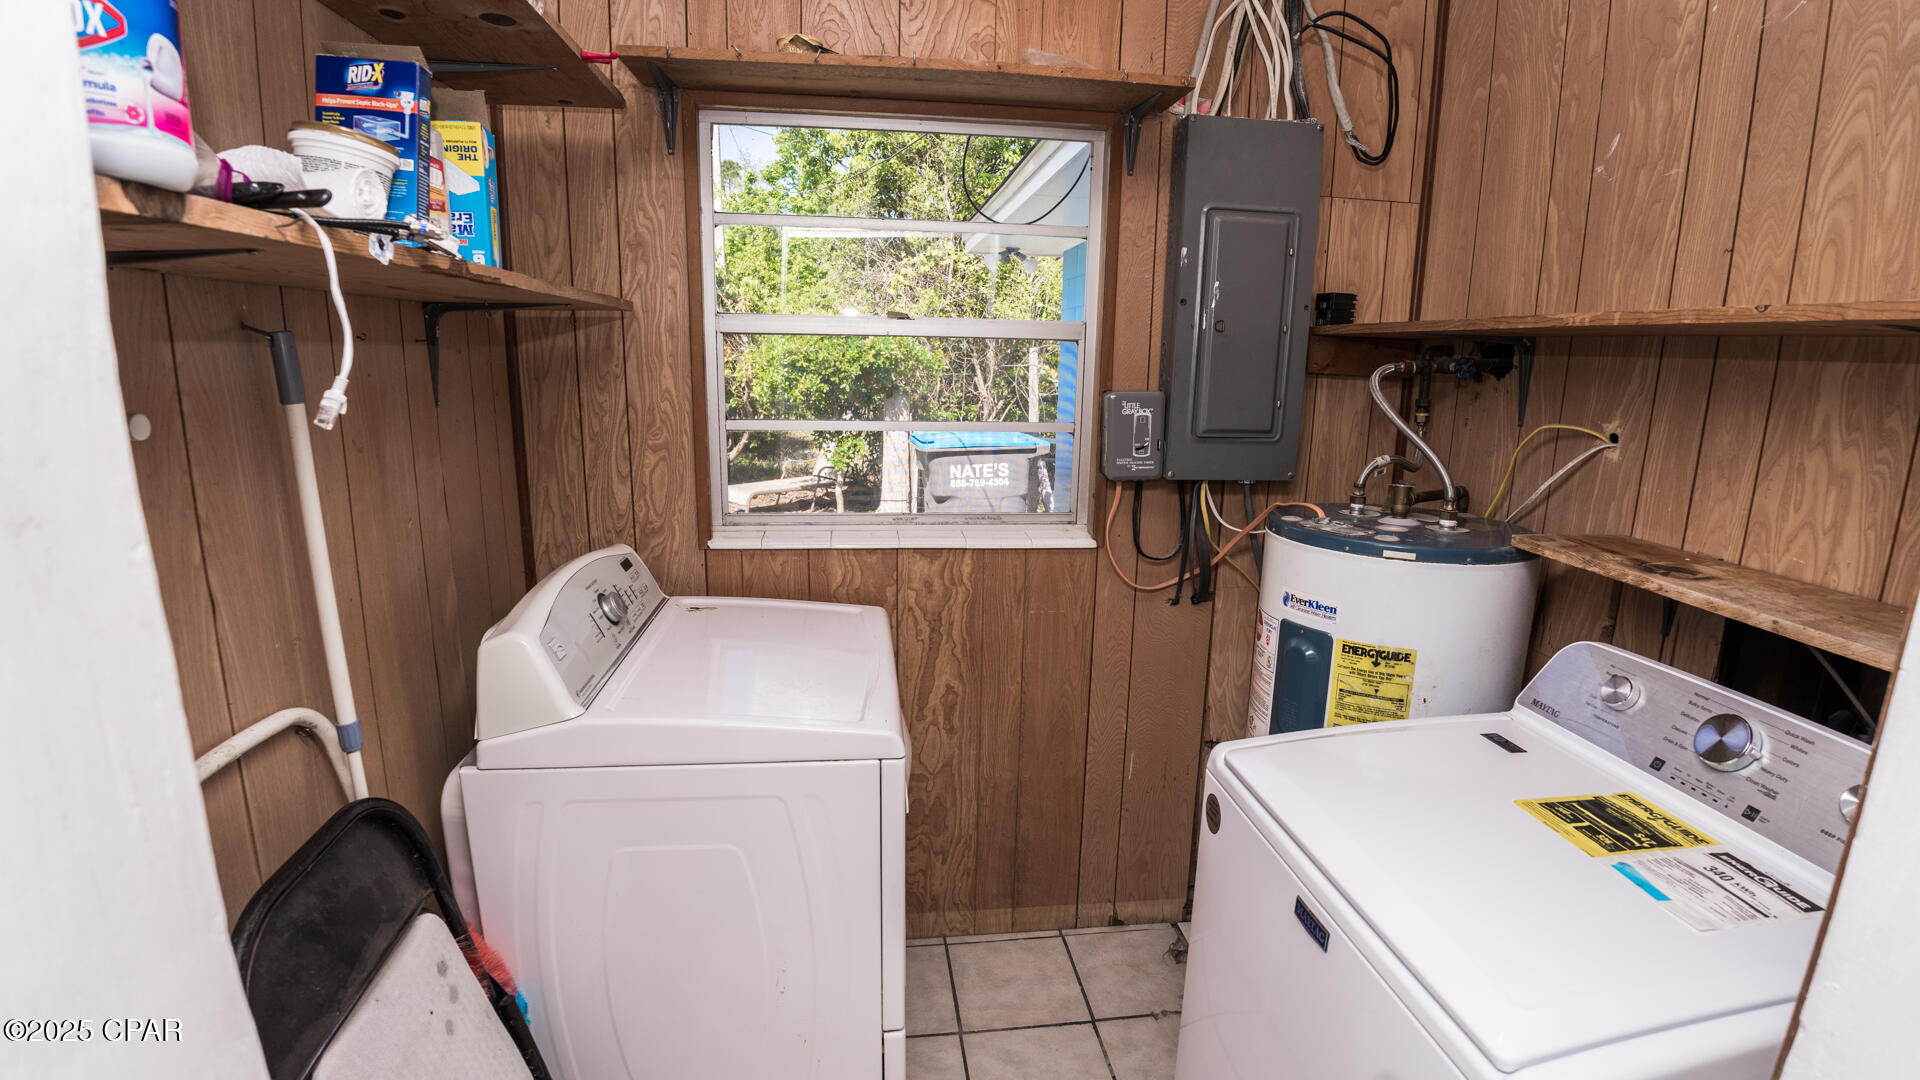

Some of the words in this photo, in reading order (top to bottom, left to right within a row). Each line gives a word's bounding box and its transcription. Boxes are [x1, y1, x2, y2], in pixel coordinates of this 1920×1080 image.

[348, 62, 384, 84] RID-X
[457, 153, 479, 161] THE
[949, 462, 1009, 478] NATE'S
[1291, 594, 1337, 615] EverKleen
[1342, 644, 1412, 666] ENERGYGUIDE
[1530, 698, 1561, 718] MAYTAG
[1784, 729, 1800, 739] Quick
[1800, 736, 1816, 746] Wash
[1790, 744, 1809, 756] Whites
[1782, 756, 1800, 768] Colors
[1760, 767, 1776, 777] Heavy
[1775, 773, 1789, 783] Duty
[1745, 776, 1760, 786] Clean
[1760, 783, 1780, 796] Washer
[1702, 864, 1735, 882] 340
